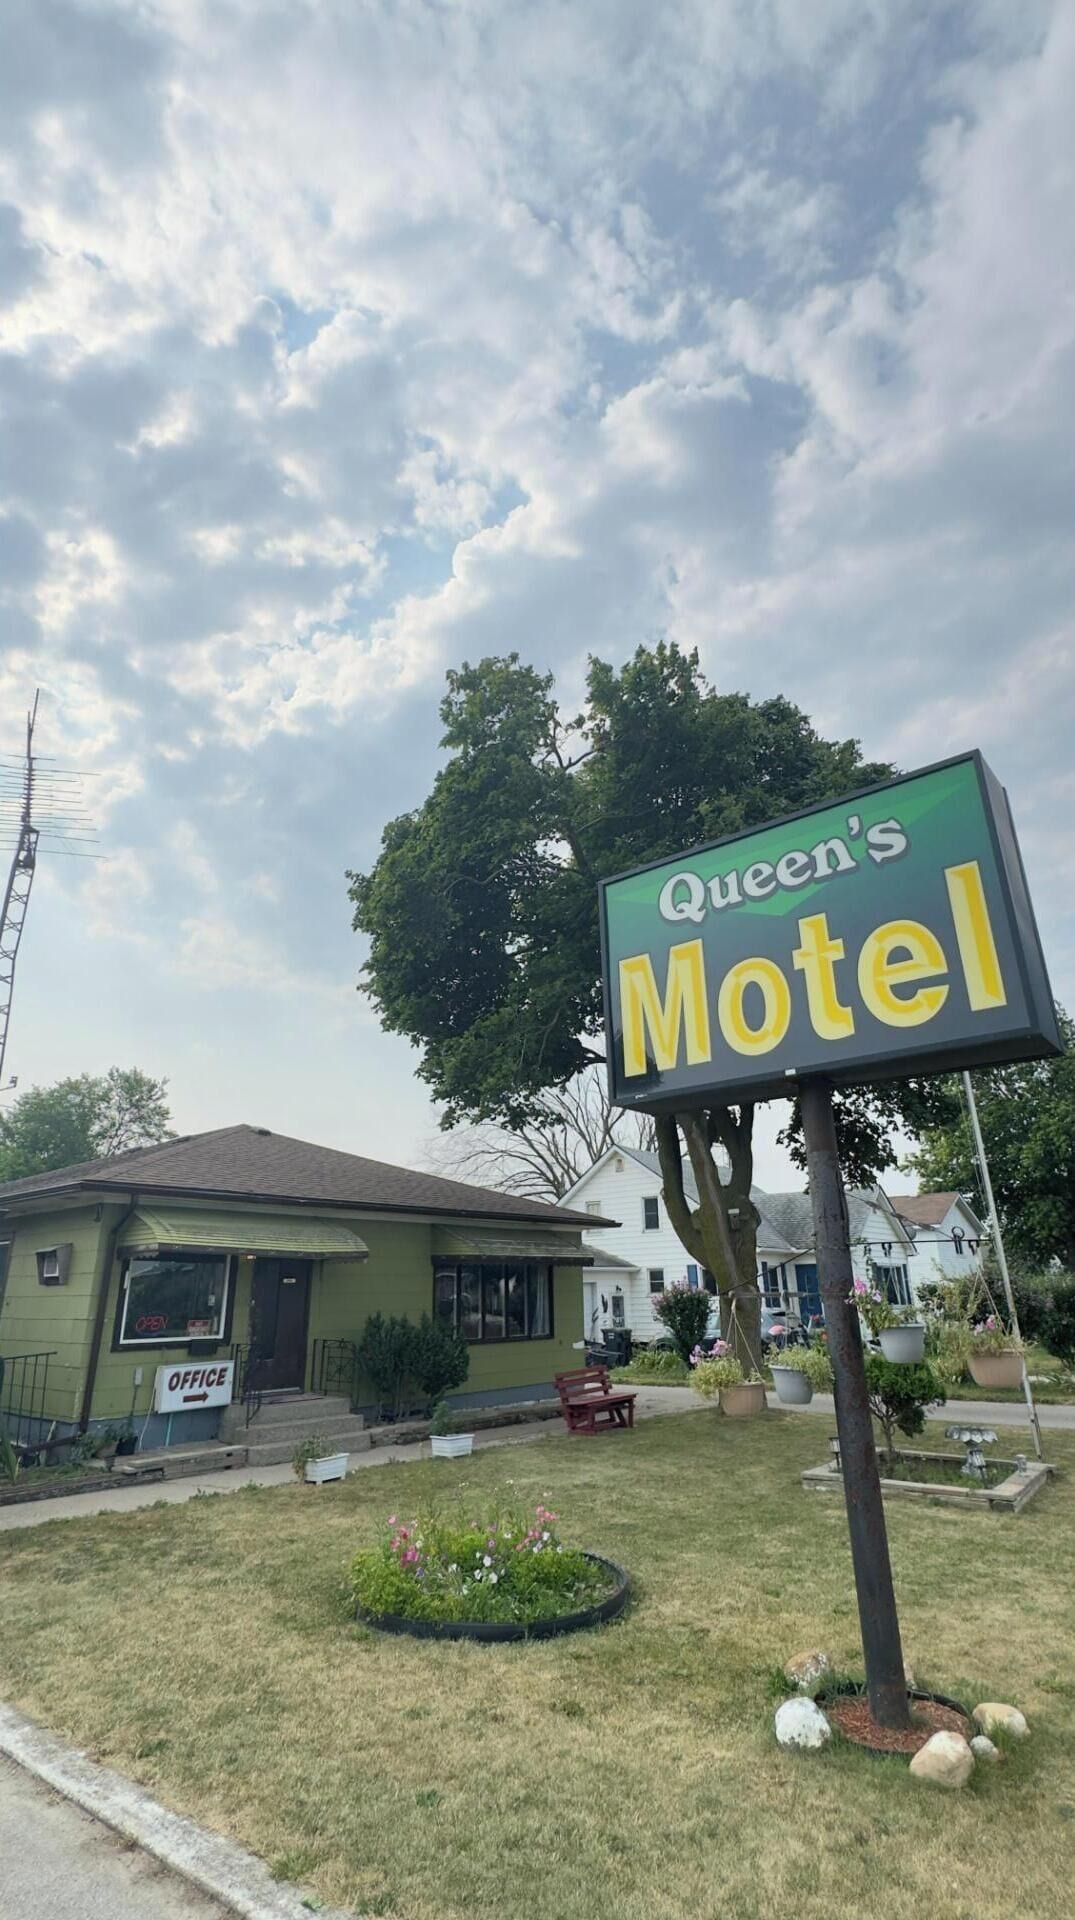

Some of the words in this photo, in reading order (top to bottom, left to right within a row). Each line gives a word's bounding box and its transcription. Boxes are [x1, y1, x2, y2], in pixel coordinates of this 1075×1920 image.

[658, 815, 908, 923] Queen's
[618, 860, 1007, 1078] Motel
[136, 1315, 168, 1331] OPEN
[168, 1367, 228, 1391] OFFICE
